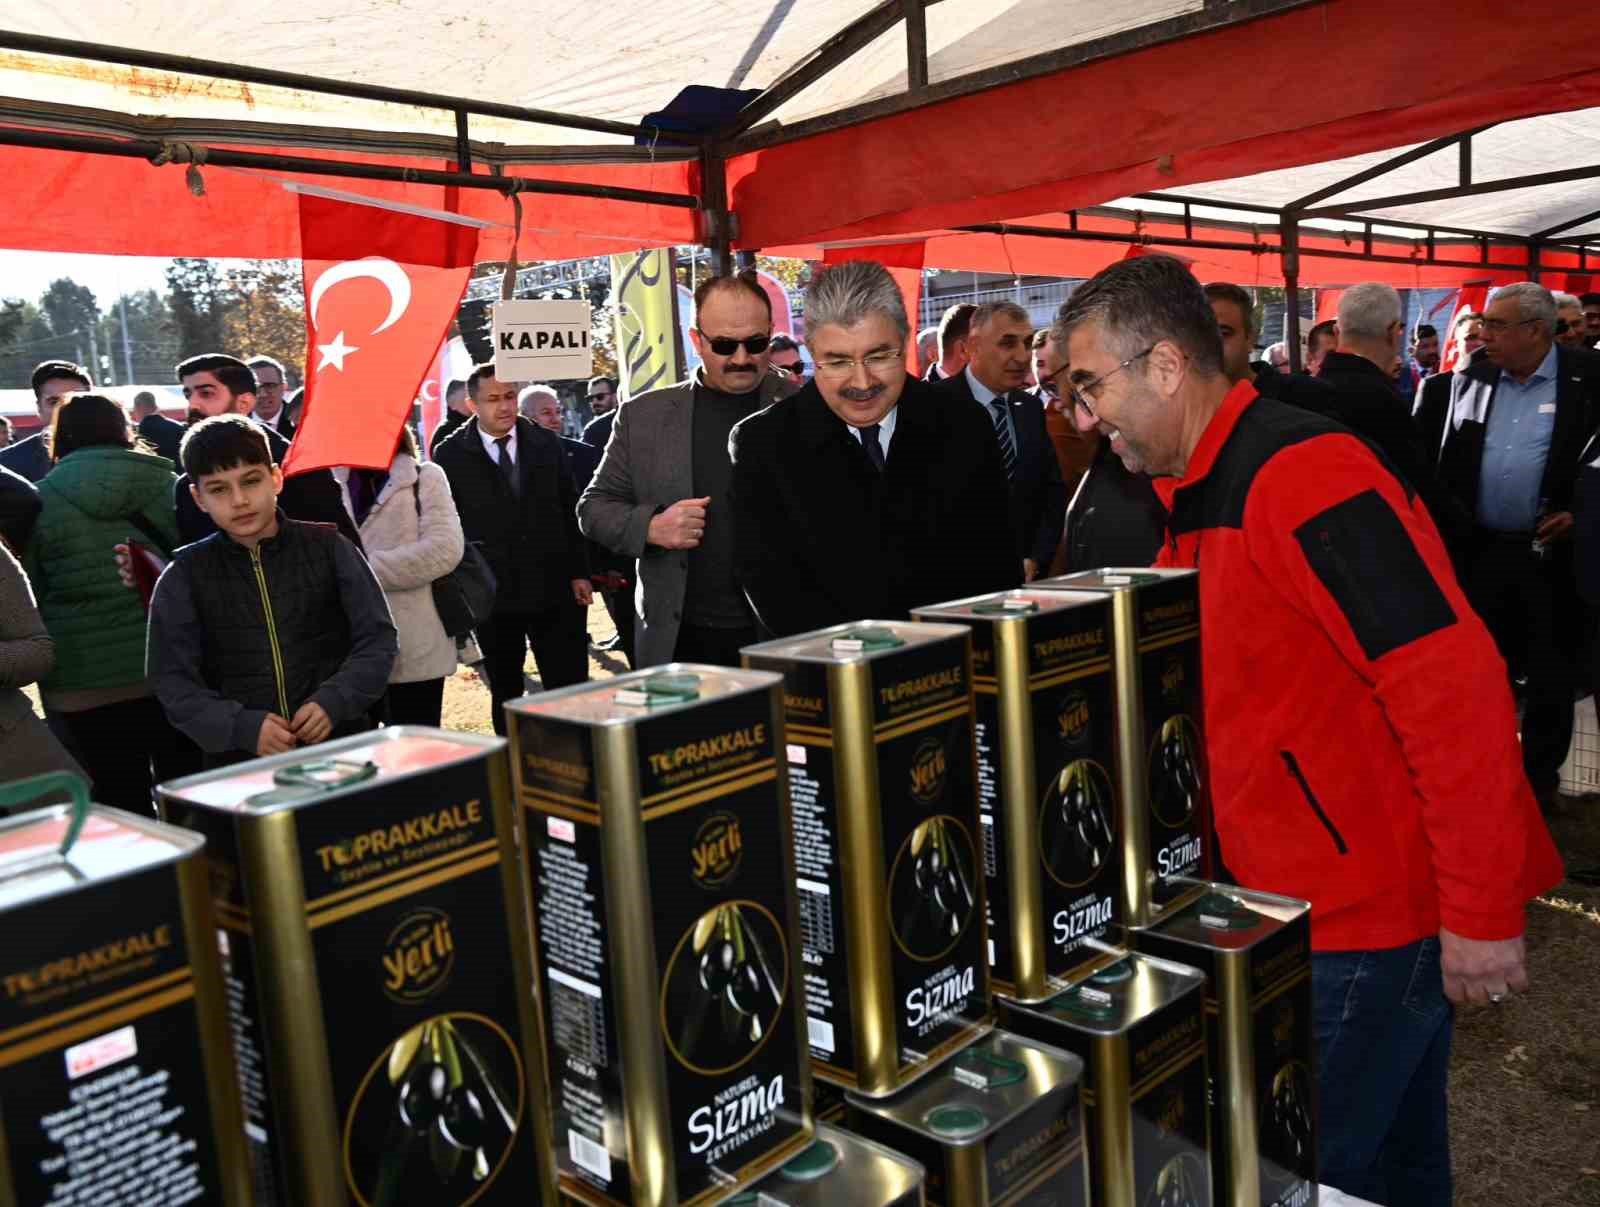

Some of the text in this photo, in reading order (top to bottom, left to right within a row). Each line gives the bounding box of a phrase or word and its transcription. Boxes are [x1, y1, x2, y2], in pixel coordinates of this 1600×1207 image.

[499, 330, 588, 350] KAPALI
[647, 723, 766, 775] TOPRAKKALE
[316, 799, 482, 873] TOPRAKKALE
[691, 823, 743, 878] yerli
[382, 919, 454, 991] yerli
[687, 1073, 785, 1154] Sızma
[714, 1074, 760, 1107] NATUREL
